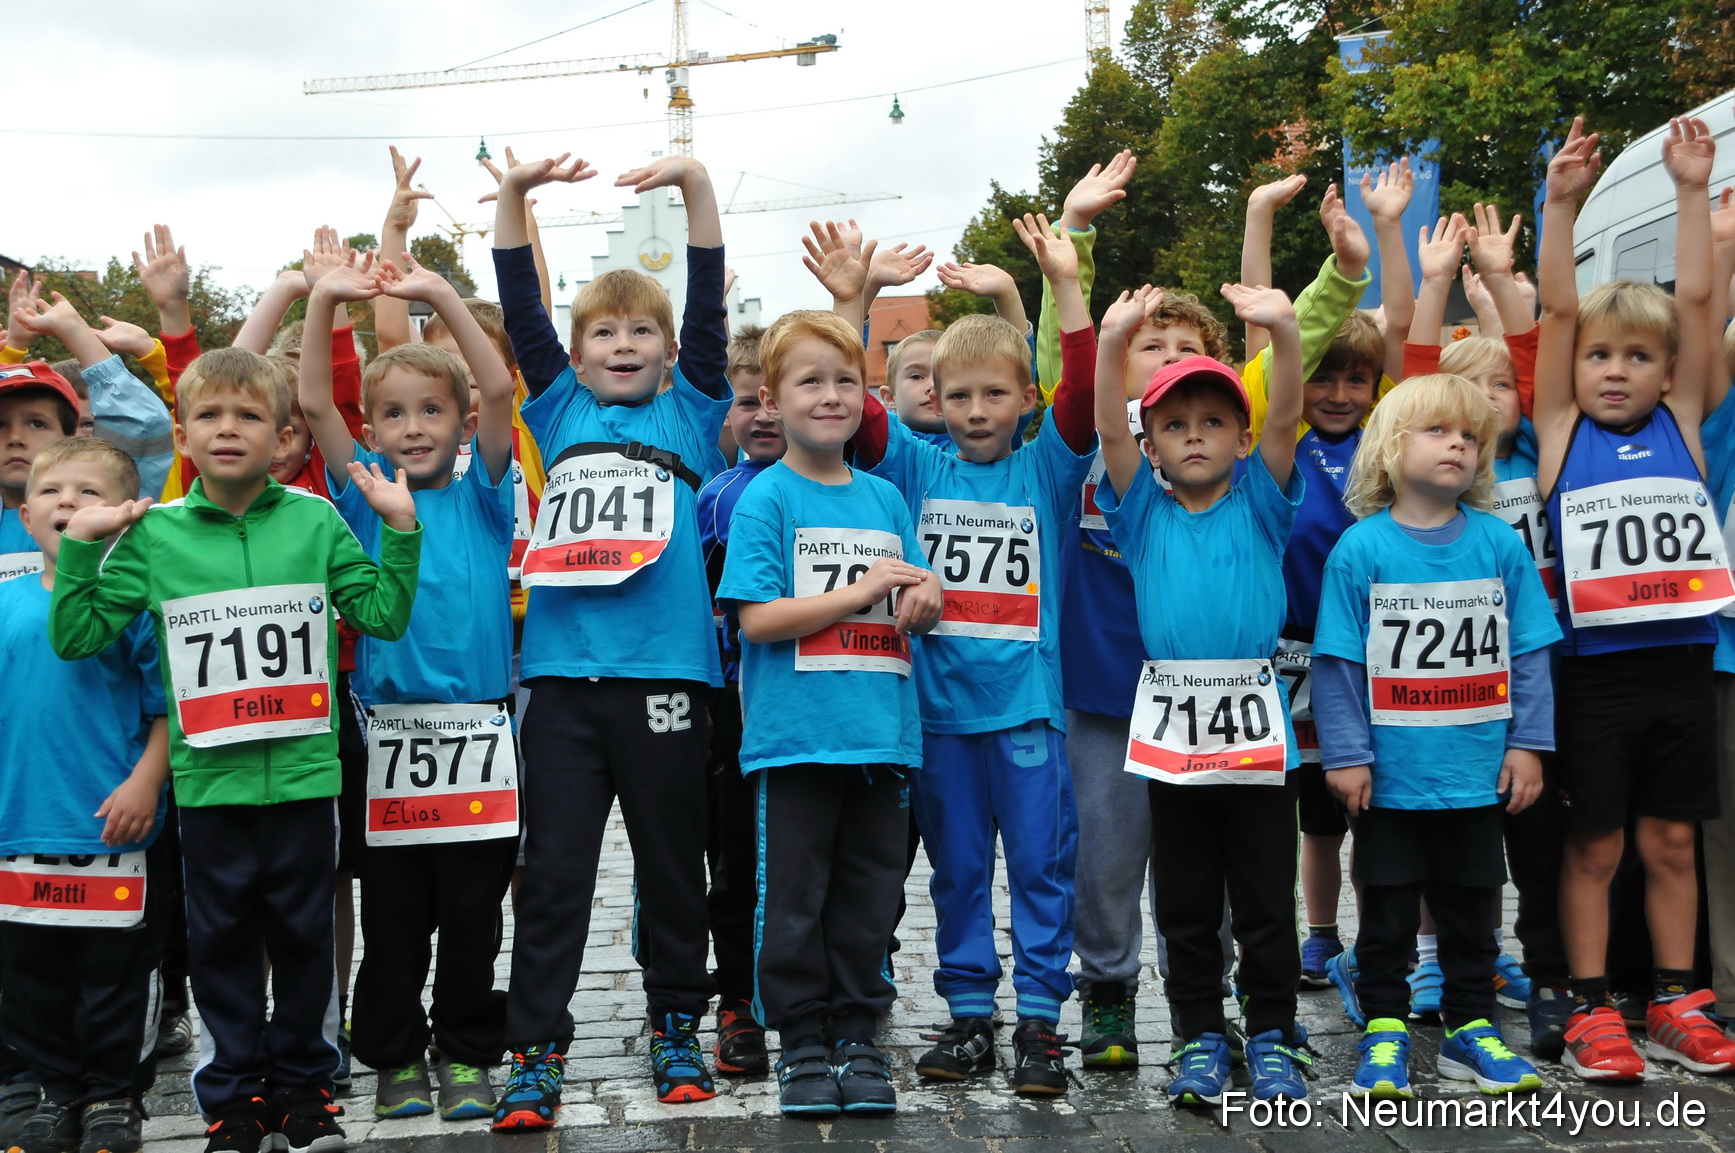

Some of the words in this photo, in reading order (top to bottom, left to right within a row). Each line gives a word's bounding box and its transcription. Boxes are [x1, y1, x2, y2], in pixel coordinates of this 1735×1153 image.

[579, 467, 650, 481] Neumarkt
[1088, 474, 1094, 482] 2
[1492, 491, 1540, 510] eumarkt
[1566, 498, 1617, 517] PARTL
[1621, 493, 1690, 507] Neumarkt
[548, 486, 655, 541] 7041
[921, 513, 952, 525] PARTL
[956, 514, 1018, 530] Neumark
[1510, 510, 1558, 561] 12
[1580, 512, 1712, 571] 7082
[565, 546, 622, 566] Lukas
[799, 543, 850, 555] PARTL
[924, 534, 1030, 587] 7575
[0, 565, 39, 578] markt
[1572, 571, 1579, 579] 2
[1627, 578, 1679, 601] Joris
[1374, 598, 1419, 610] PARTL
[1424, 595, 1489, 610] Neumarkt
[168, 609, 222, 630] PARTL
[226, 600, 304, 619] Neumarkt
[1382, 614, 1500, 670] 7244
[185, 621, 312, 688] 7191
[319, 671, 324, 680] K
[1142, 673, 1179, 687] PARTL
[1183, 674, 1253, 687] Neumarkt
[1374, 666, 1380, 675] 2
[181, 688, 187, 698] 2
[1391, 682, 1496, 705] Maximilian
[233, 694, 285, 719] Felix
[646, 692, 692, 733] 52
[370, 718, 411, 731] PARTL
[413, 718, 484, 731] Neumarkt
[1152, 693, 1271, 746] 7140
[1272, 734, 1279, 743] K
[379, 733, 500, 789] 7577
[1180, 758, 1229, 772] Jona
[504, 777, 511, 787] K
[382, 800, 441, 825] Elias
[133, 864, 140, 873] K
[33, 881, 86, 904] Matti
[1273, 1044, 1293, 1055] FILA
